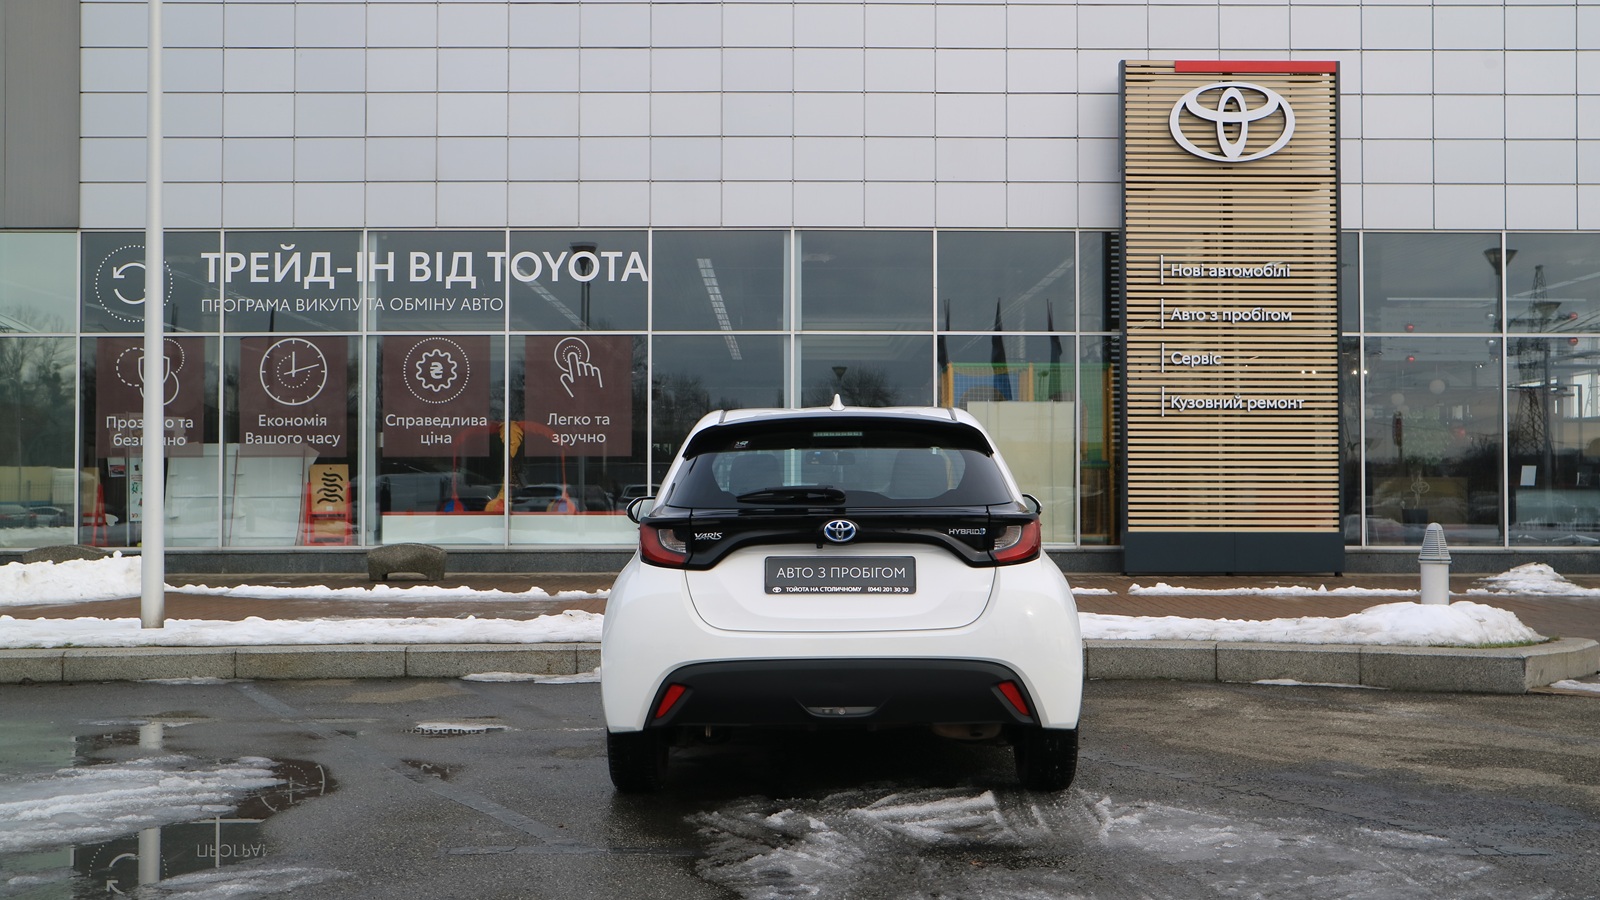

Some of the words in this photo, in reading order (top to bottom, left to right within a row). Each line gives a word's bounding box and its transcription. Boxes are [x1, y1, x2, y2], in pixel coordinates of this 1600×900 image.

[201, 243, 394, 290] ТРЕЙД-ІН
[409, 251, 476, 289] ВІД
[487, 251, 648, 282] TOYOTA
[1170, 263, 1204, 277] Нові
[1208, 263, 1290, 277] автомобілі
[201, 298, 291, 312] ПРОГРАМА
[296, 298, 362, 311] ВИКУПУ
[366, 297, 385, 311] ТА
[389, 297, 457, 311] ОБМІНУ
[460, 297, 504, 311] АВТО
[1170, 307, 1205, 321] Авто
[1209, 310, 1218, 321] з
[1222, 307, 1292, 323] пробігом
[1170, 351, 1222, 367] Сервіс
[1170, 395, 1242, 412] Кузовний
[1247, 398, 1304, 412] ремонт
[106, 416, 175, 431] Прозо
[178, 418, 194, 428] та
[258, 413, 327, 427] Економія
[385, 414, 488, 428] Справедлива
[547, 413, 591, 426] Легко
[595, 414, 610, 426] та
[113, 433, 187, 446] безно
[245, 432, 302, 445] Вашого
[307, 434, 341, 447] часу
[420, 431, 452, 446] ціна
[551, 433, 606, 446] зручно
[694, 531, 723, 541] YARIS
[776, 567, 814, 579] АВТО
[818, 567, 826, 579] З
[830, 567, 906, 579] ПРОБІГОМ
[786, 585, 809, 593] ТОЙОТА
